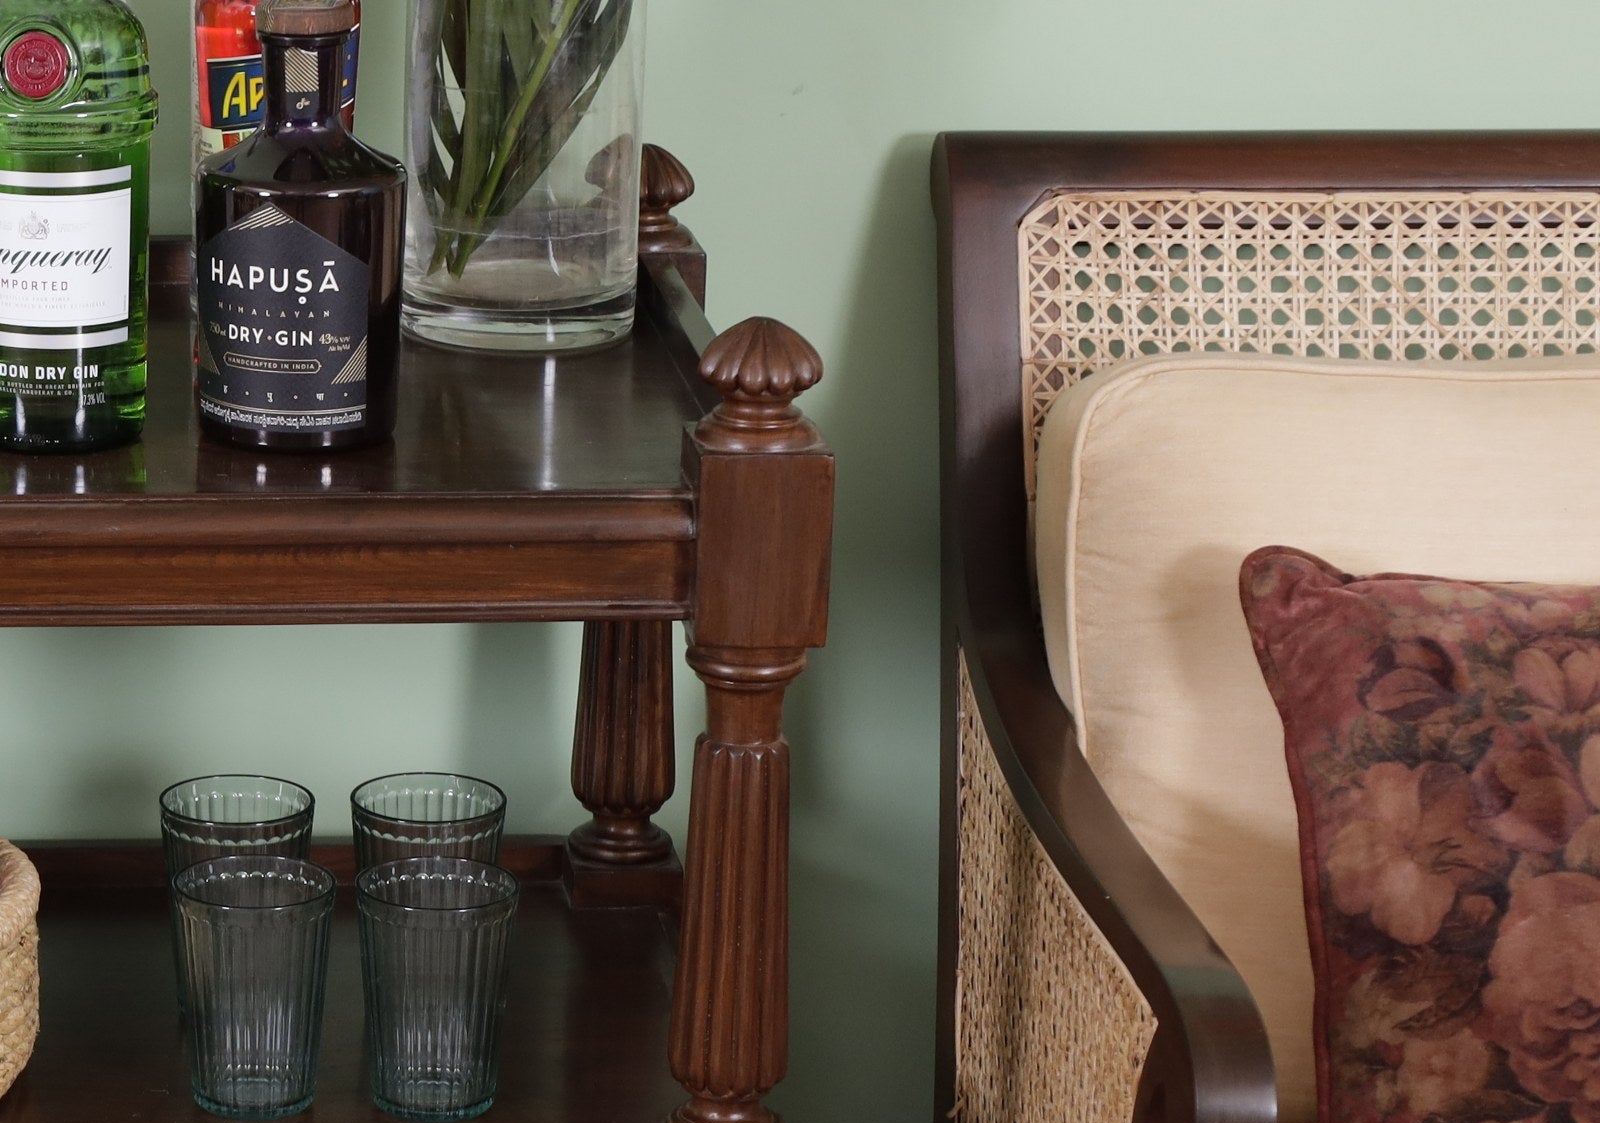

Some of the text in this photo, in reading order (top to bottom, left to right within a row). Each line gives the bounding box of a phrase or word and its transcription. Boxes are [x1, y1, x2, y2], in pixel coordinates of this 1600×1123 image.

[218, 301, 331, 318] HIMALAYAN
[228, 323, 264, 344] DRY
[275, 330, 313, 346] GIN
[227, 356, 278, 369] HANDCRAFTED
[35, 366, 67, 380] DRY
[73, 364, 98, 379] GIN
